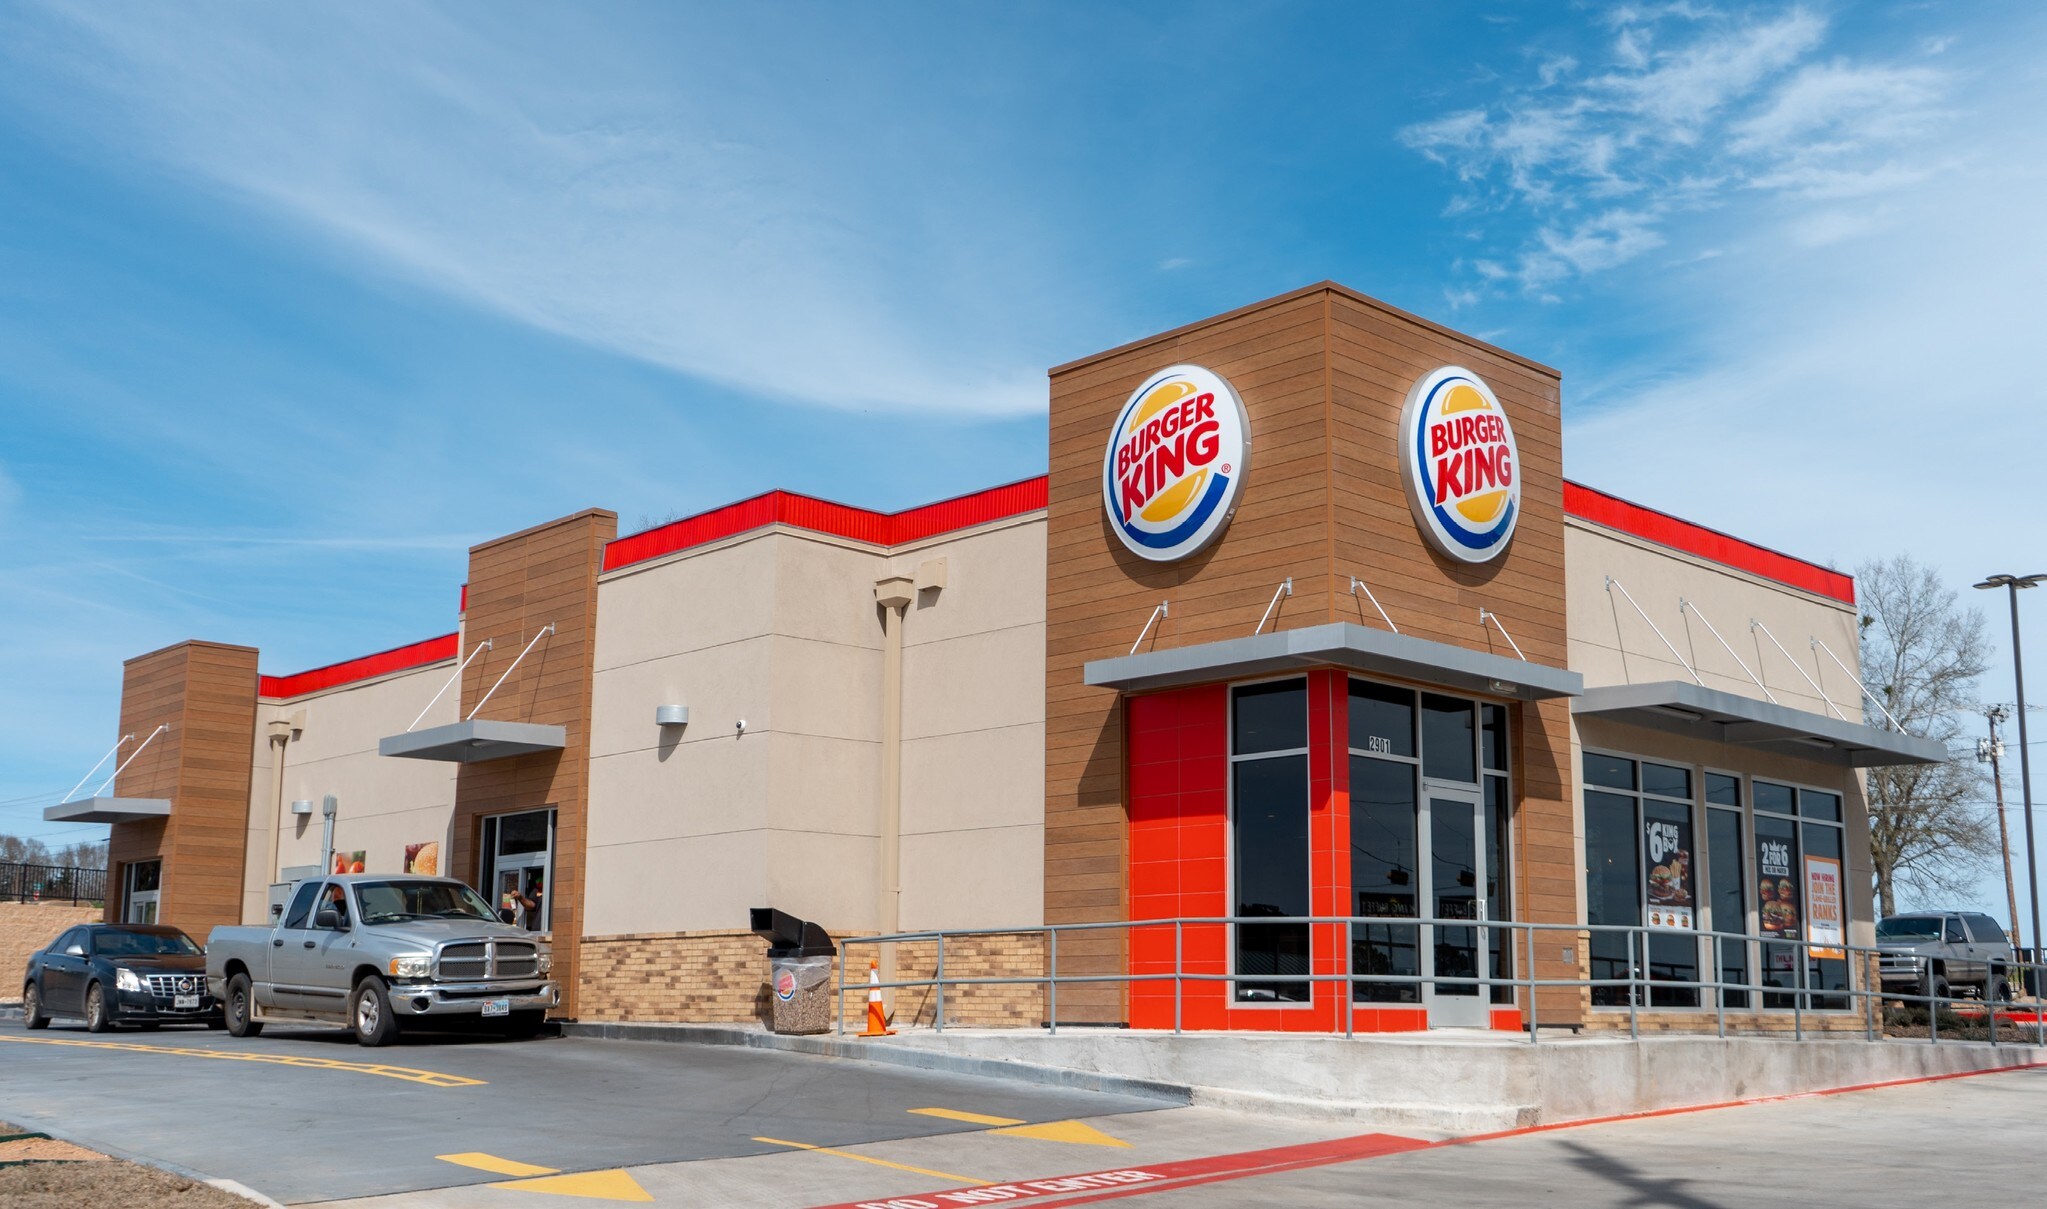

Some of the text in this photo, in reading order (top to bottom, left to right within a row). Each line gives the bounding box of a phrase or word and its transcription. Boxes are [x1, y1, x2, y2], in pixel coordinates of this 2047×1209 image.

[1118, 392, 1215, 481] BURGER
[1431, 414, 1507, 458] BURGER
[1122, 420, 1220, 523] KING
[1436, 444, 1512, 505] KING
[1370, 736, 1390, 754] 2901
[1662, 823, 1679, 839] KING
[1761, 842, 1769, 865] 2
[1769, 851, 1781, 866] FOR
[1811, 872, 1820, 881] NOW
[1812, 881, 1835, 896] JOIN THE
[1813, 903, 1838, 922] RANKS
[934, 1186, 1040, 1203] NOT
[1022, 1170, 1167, 1192] ENTER
